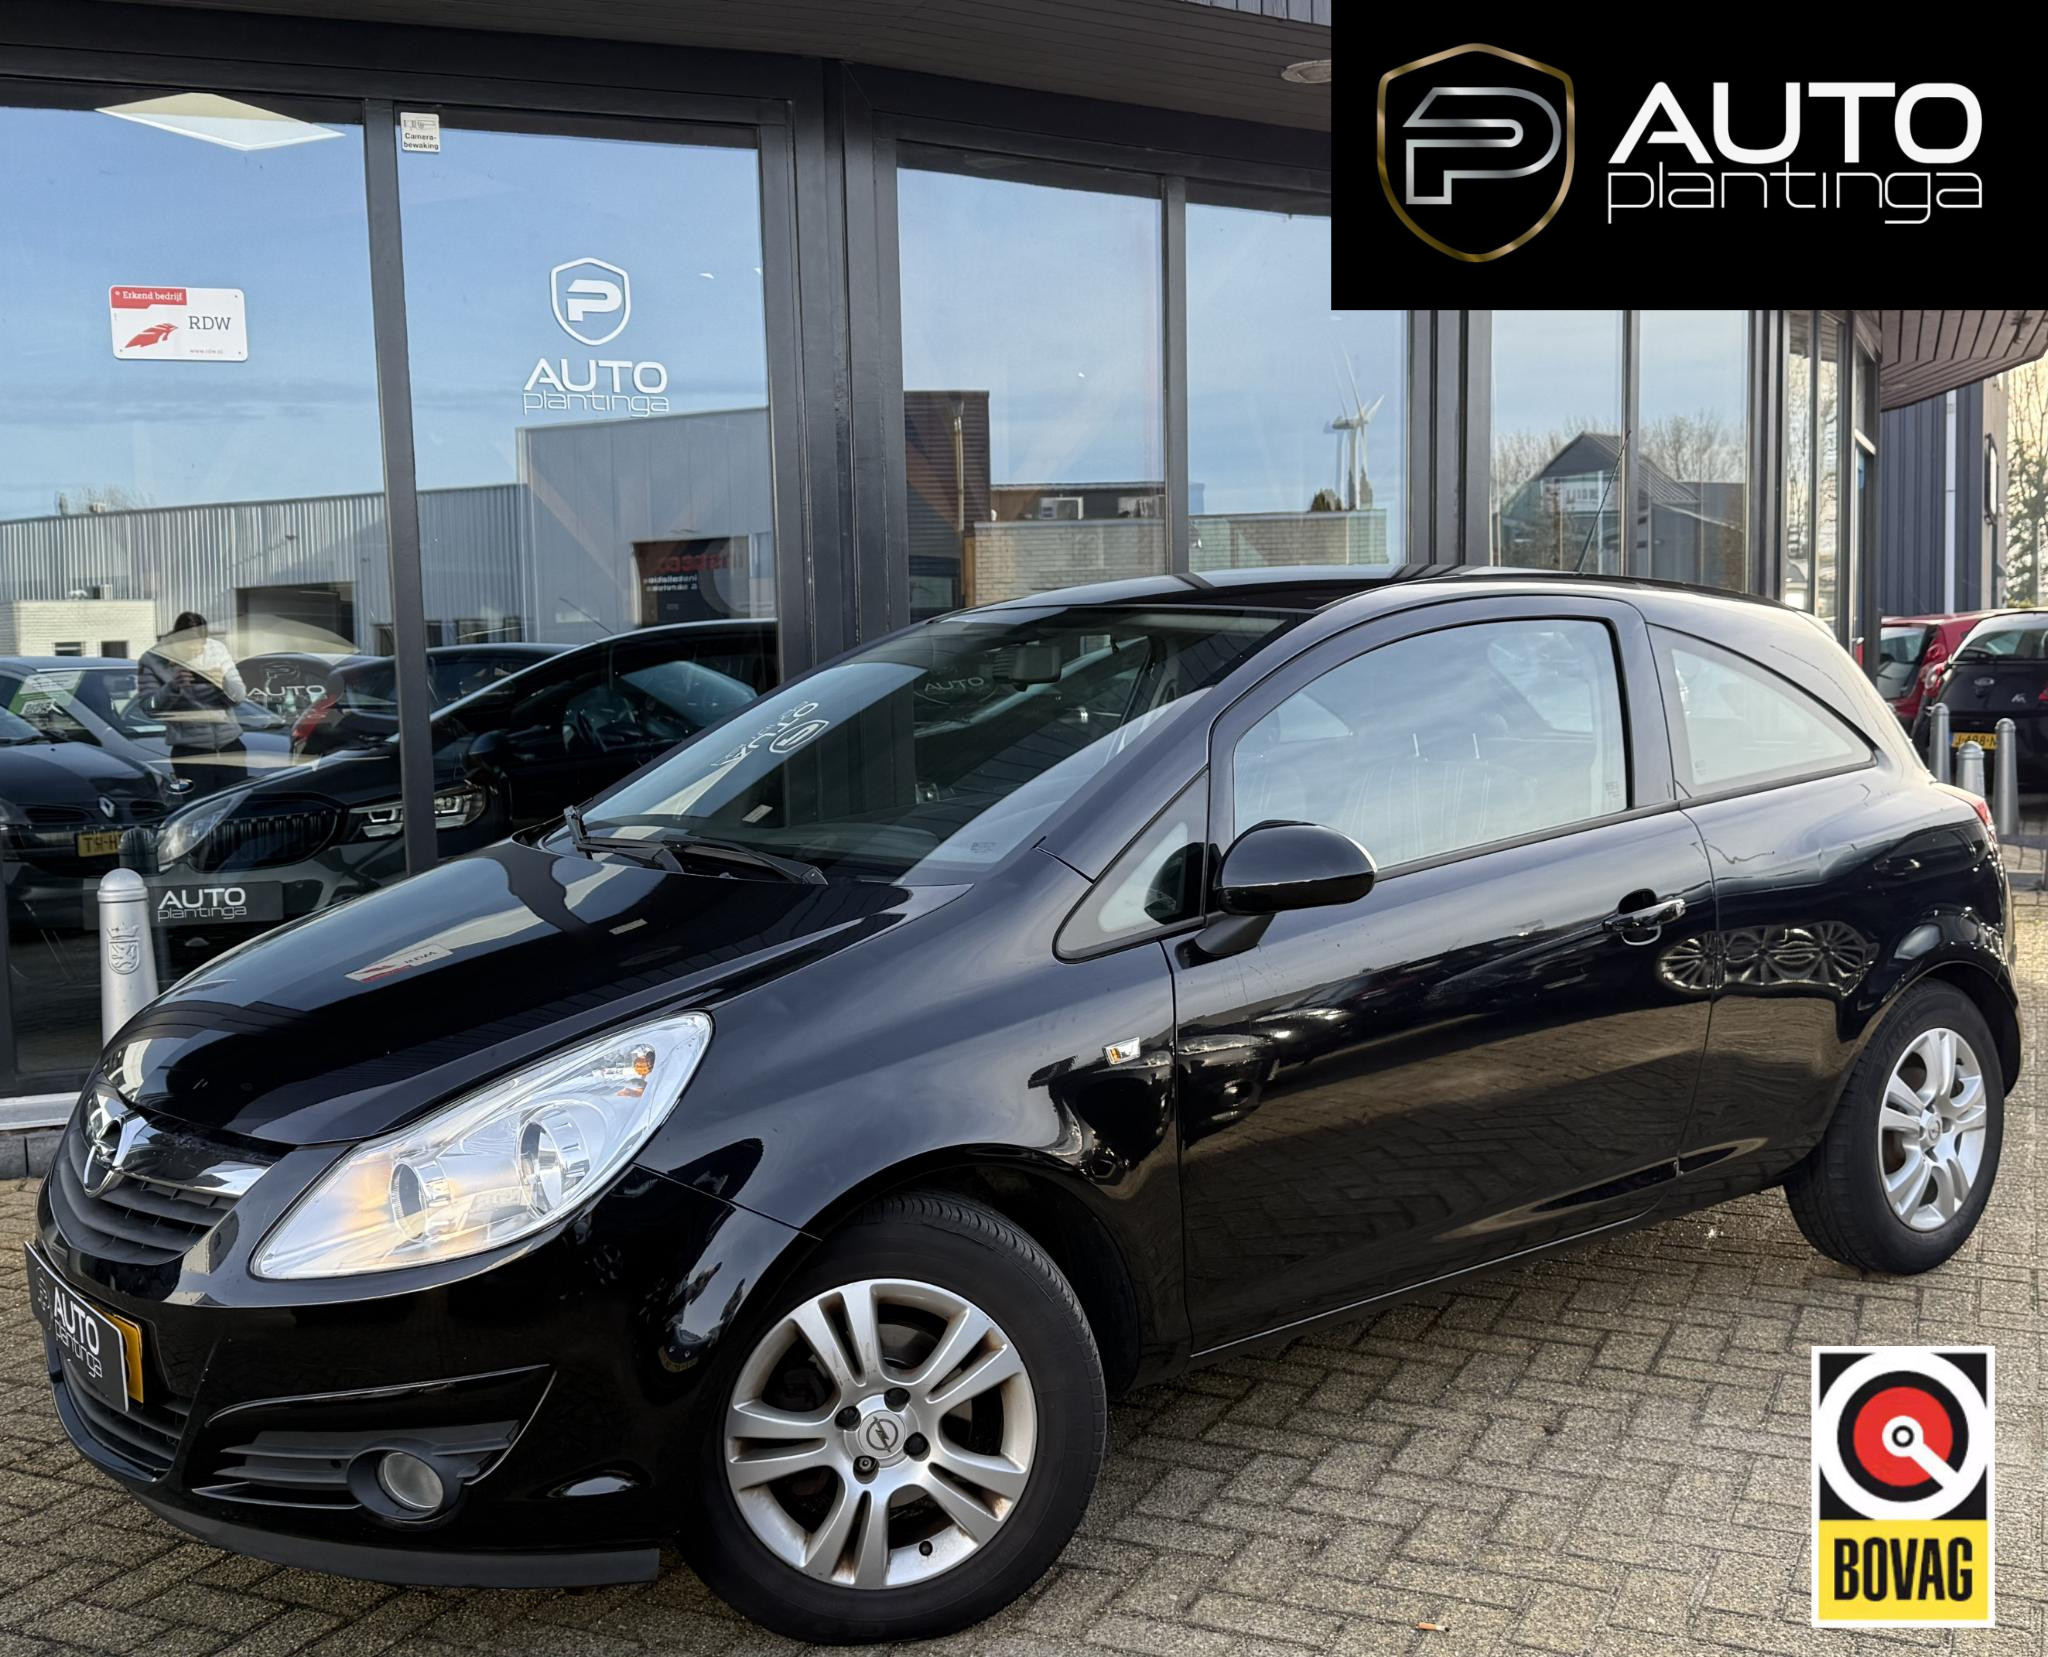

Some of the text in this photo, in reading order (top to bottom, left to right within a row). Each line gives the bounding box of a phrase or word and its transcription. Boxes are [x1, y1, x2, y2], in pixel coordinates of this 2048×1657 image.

[404, 133, 437, 141] Camera-
[403, 141, 439, 150] bewaking
[122, 291, 184, 302] Erkend bedrijf
[188, 315, 231, 331] RDW
[523, 358, 668, 394] AUTO
[523, 390, 670, 418] plantinga
[247, 685, 327, 697] AUTO
[924, 677, 984, 692] AUTO
[158, 887, 246, 909] AUTO
[157, 906, 248, 922] plantinga
[54, 1287, 99, 1355] AUTO
